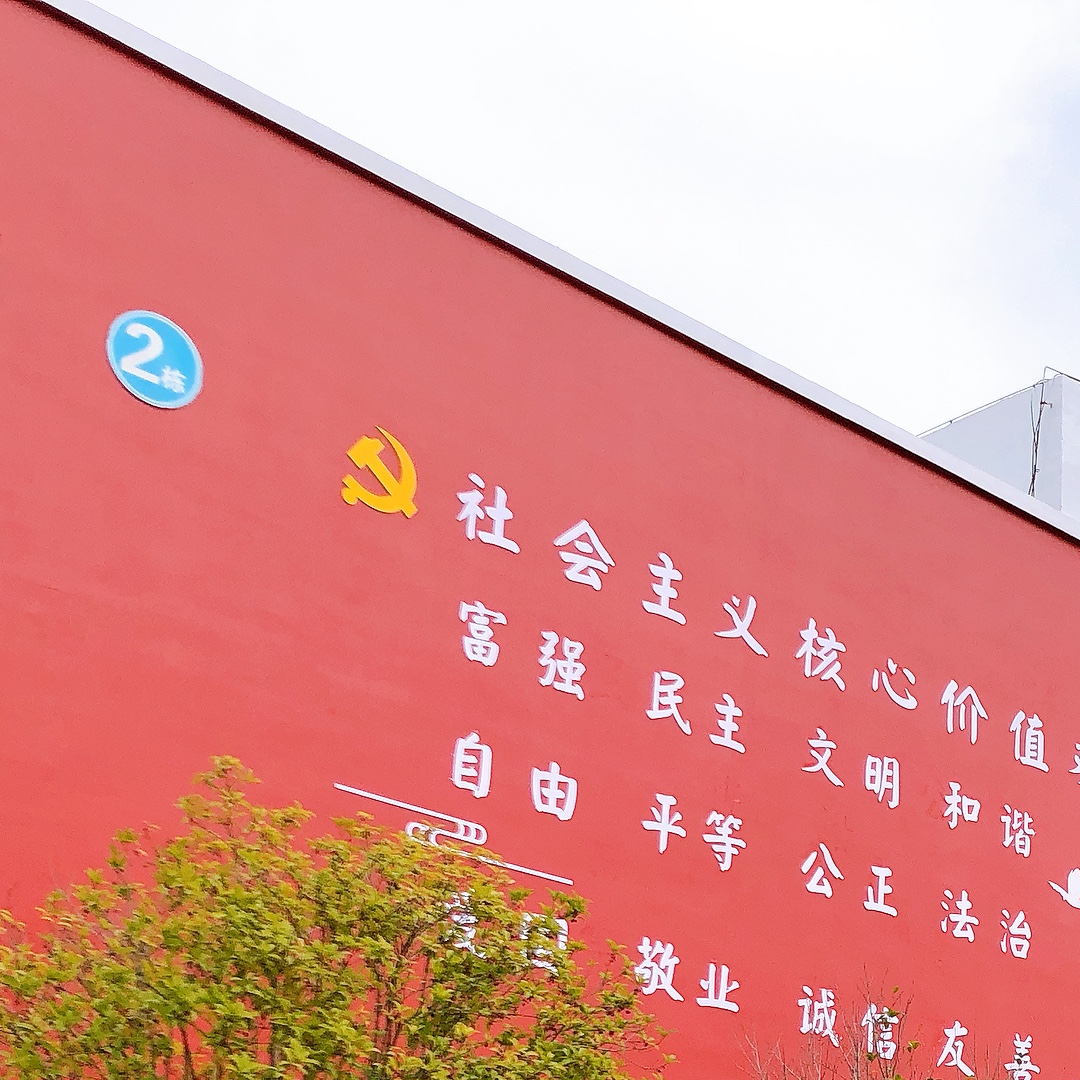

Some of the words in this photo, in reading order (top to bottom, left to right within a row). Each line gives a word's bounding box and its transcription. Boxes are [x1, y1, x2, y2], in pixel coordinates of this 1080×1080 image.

[458, 600, 587, 701] 富强
[645, 670, 746, 754] 民主
[801, 728, 900, 809] 文明
[943, 781, 1037, 858] 和谐
[450, 732, 578, 821] 自由
[641, 793, 747, 872] 平等
[800, 843, 898, 917] 公正
[940, 889, 1032, 959] 法治
[634, 936, 740, 1013] 敬业
[797, 985, 900, 1060] 诚信
